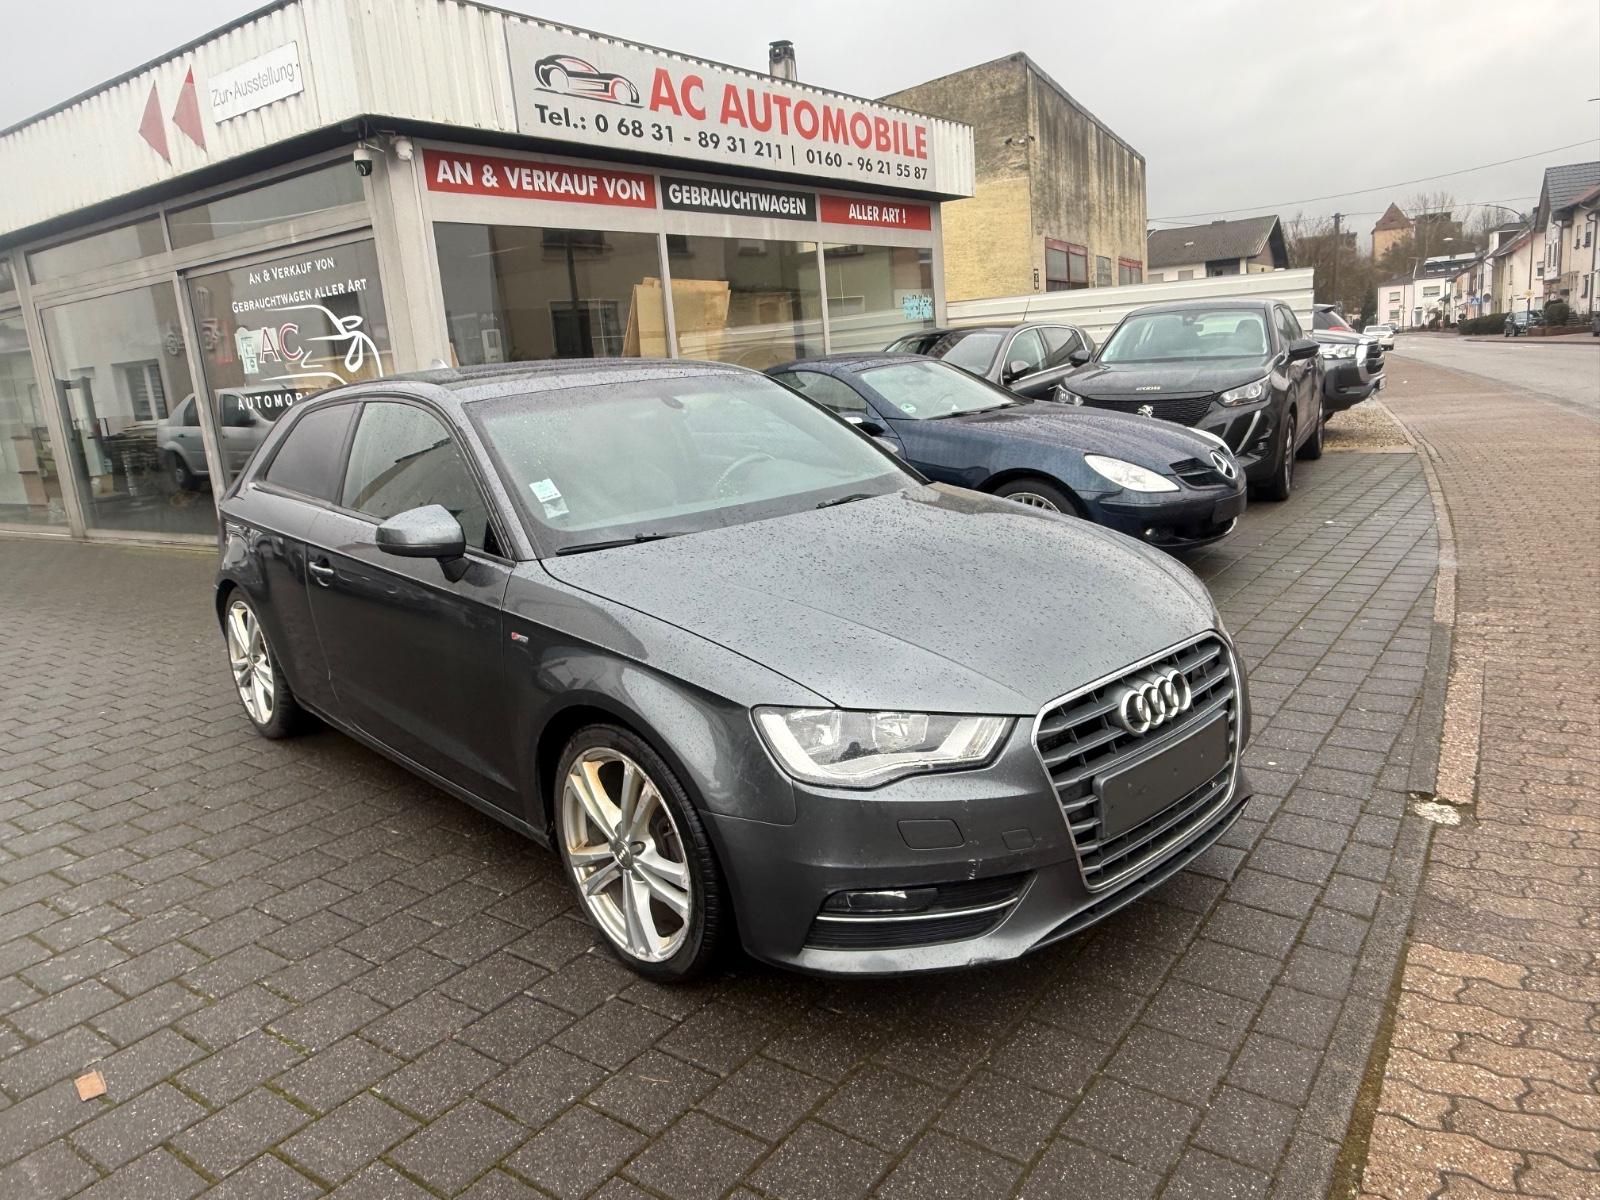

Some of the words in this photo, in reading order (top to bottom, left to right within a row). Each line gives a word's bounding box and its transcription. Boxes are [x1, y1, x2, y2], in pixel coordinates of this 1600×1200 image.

[212, 88, 229, 107] Zur
[234, 62, 295, 100] Ausstellung
[649, 67, 707, 121] AC
[719, 83, 928, 160] AUTOMOBILE
[535, 103, 587, 130] Tel.:
[595, 114, 609, 132] 0
[617, 118, 644, 138] 68
[651, 123, 674, 143] 31
[698, 131, 721, 149] 89
[727, 136, 746, 154] 31
[754, 140, 782, 160] 211
[806, 149, 842, 167] 0160
[857, 156, 873, 172] 96
[877, 160, 891, 175] 21
[896, 163, 911, 178] 55
[914, 167, 928, 180] 87
[436, 159, 474, 185] AN
[481, 164, 499, 188] &
[503, 166, 599, 197] VERKAUF
[602, 176, 646, 201] VON
[668, 184, 807, 215] GEBRAUCHTWAGEN
[849, 203, 880, 221] ALLER
[882, 206, 900, 223] ART
[263, 269, 271, 281] &
[259, 322, 304, 364] AC
